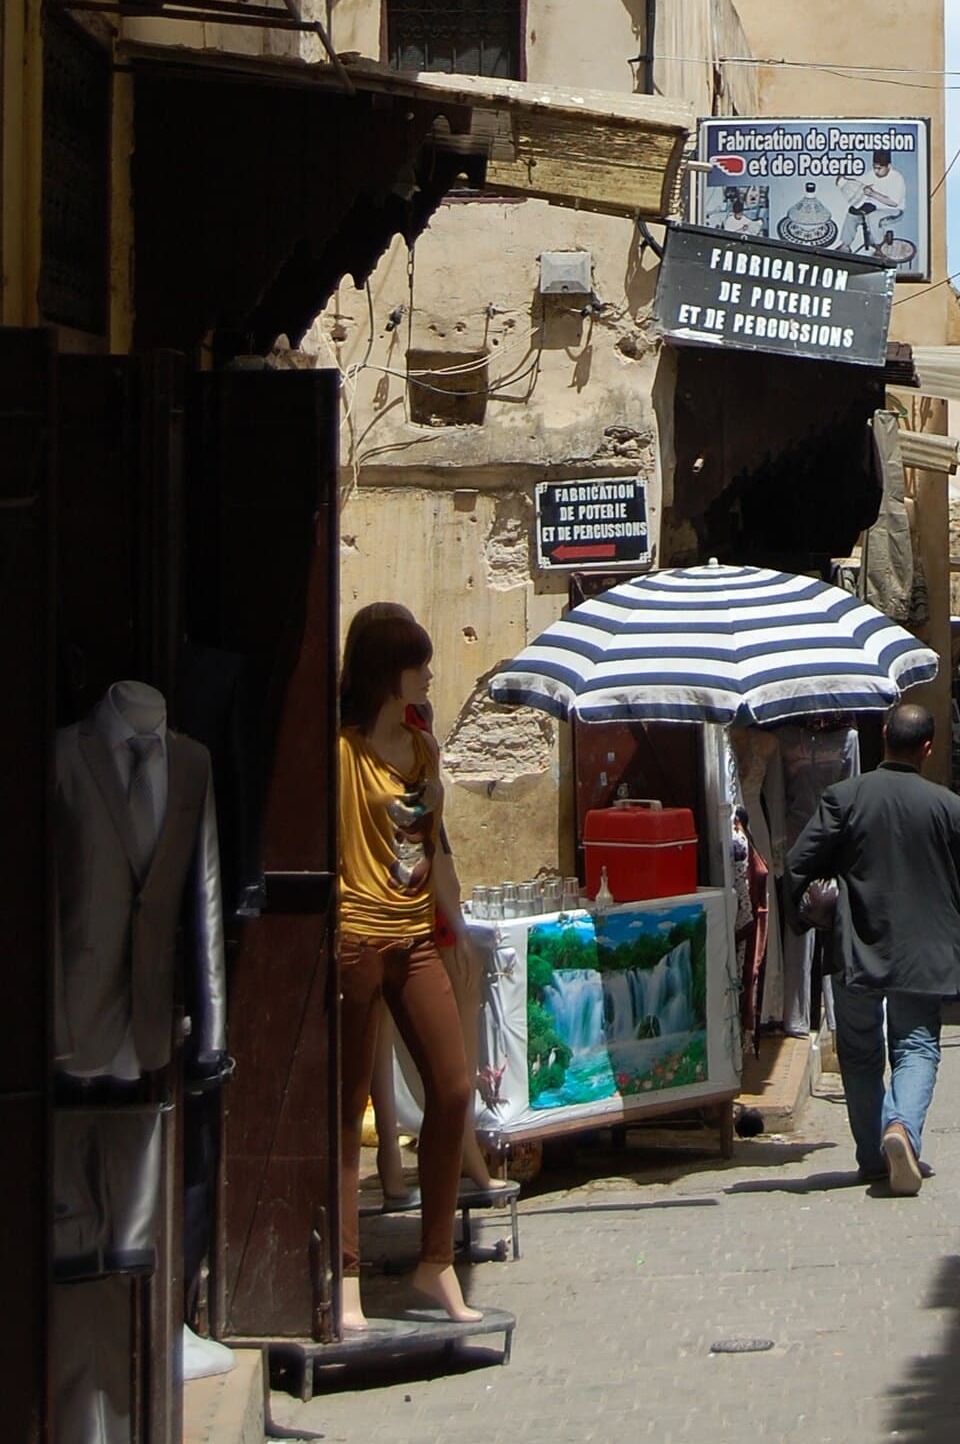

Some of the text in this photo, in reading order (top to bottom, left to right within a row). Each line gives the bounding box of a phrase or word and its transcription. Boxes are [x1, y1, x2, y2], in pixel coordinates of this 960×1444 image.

[717, 128, 914, 152] Fabrication de Percussion
[749, 154, 865, 176] et de Poterie
[710, 247, 848, 291] FABRICATION
[718, 281, 832, 318] DE POTERIE
[678, 304, 855, 347] ET DE PERCUSSIONS
[555, 484, 635, 502] FABRICATION
[560, 503, 628, 521] DE POTERIE
[542, 521, 648, 542] ET DE PERCUSSIONS
